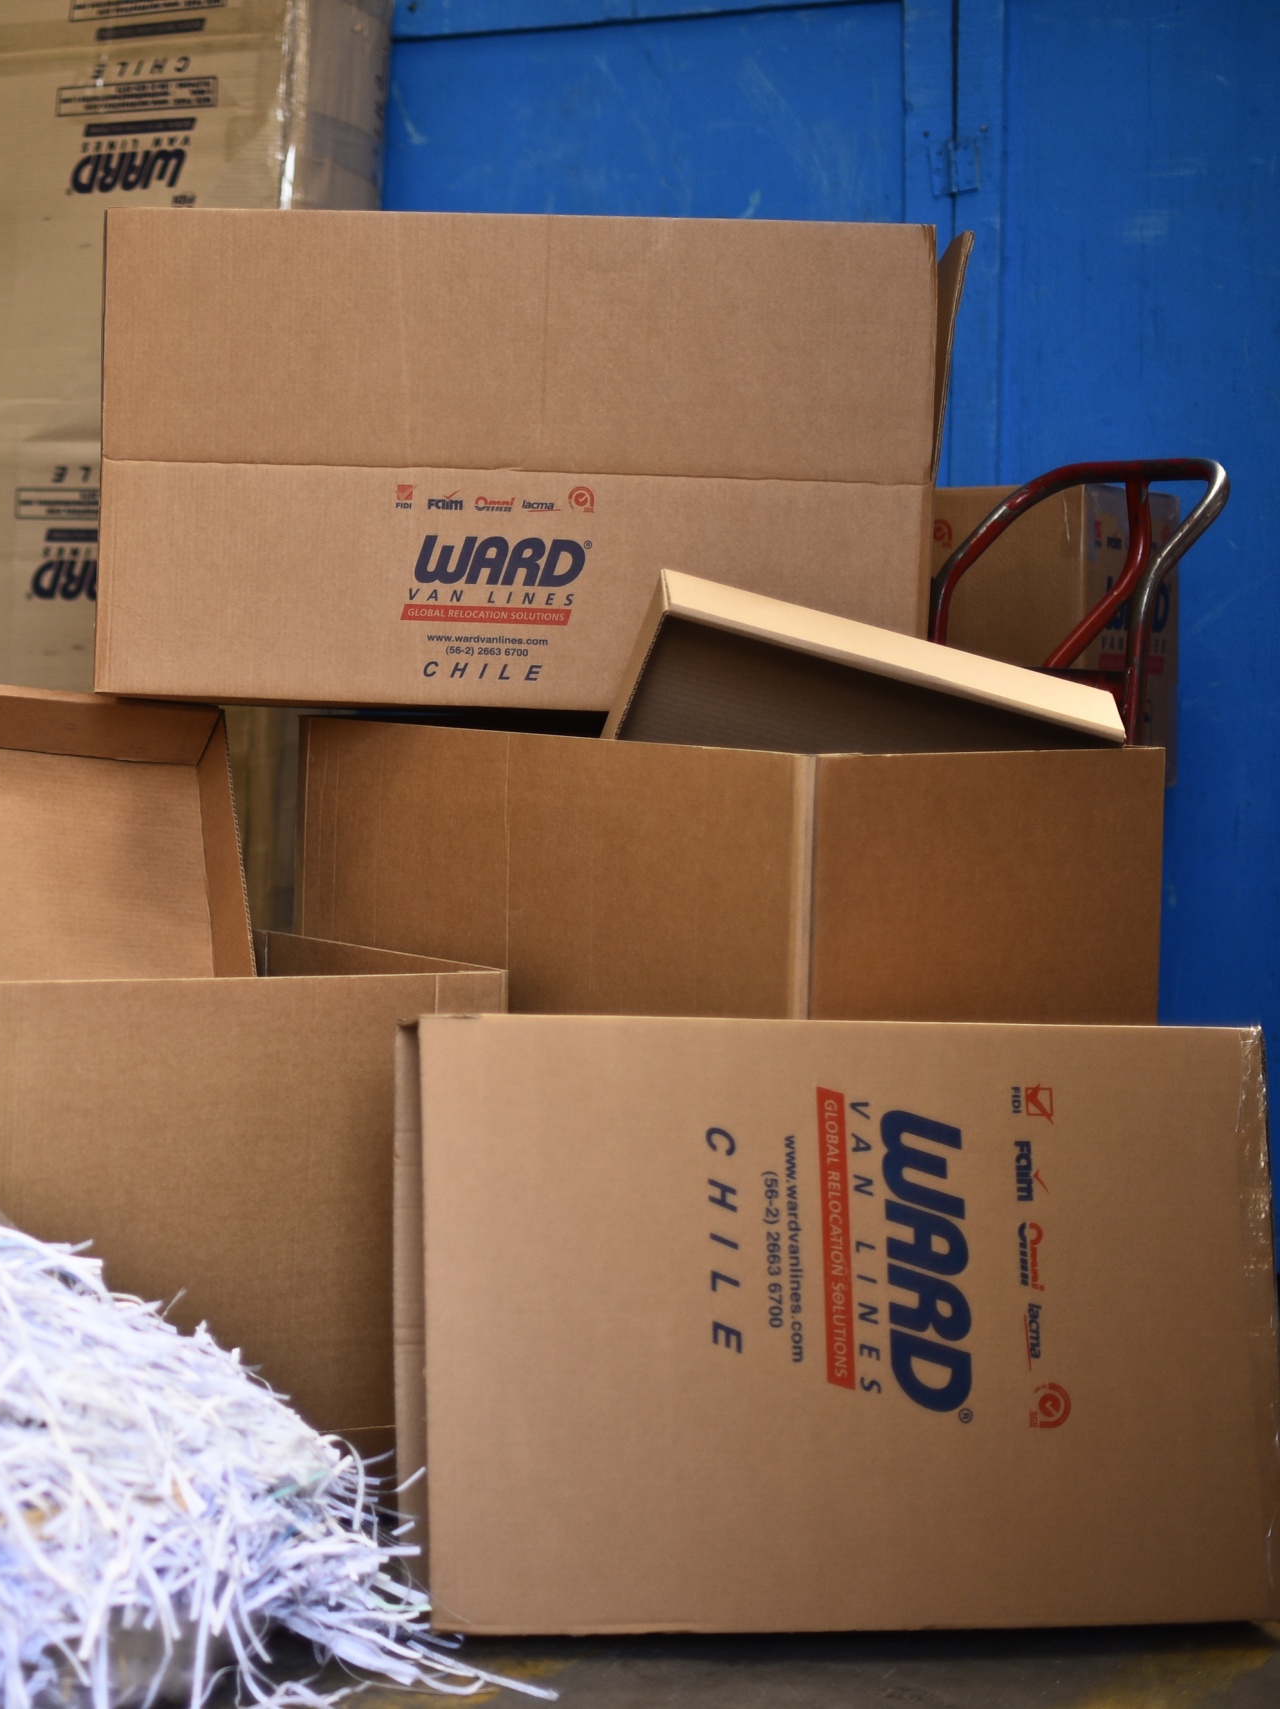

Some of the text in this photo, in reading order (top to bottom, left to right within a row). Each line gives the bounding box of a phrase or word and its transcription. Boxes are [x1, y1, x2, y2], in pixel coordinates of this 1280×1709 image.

[521, 500, 554, 511] lacma
[408, 588, 575, 606] VAN LINES
[414, 534, 586, 587] WARD
[407, 607, 565, 622] GLOBAL RELOCATION SOLUTIONS
[427, 634, 549, 647] www.wardvanlines.com
[445, 646, 529, 658] (56-2) 2663 6700
[422, 661, 543, 682] CHILE
[705, 1126, 743, 1354] CHILE
[760, 1170, 784, 1329] (56-2) 2663 6700
[784, 1135, 804, 1363] www.wardvanlines.com
[824, 1099, 848, 1377] GLOBAL RELOCATION SOLUTIONS
[849, 1100, 881, 1394] VAN LINES
[880, 1109, 973, 1413] WARD
[1011, 1086, 1021, 1114] FIDI
[1027, 1302, 1042, 1360] lacma
